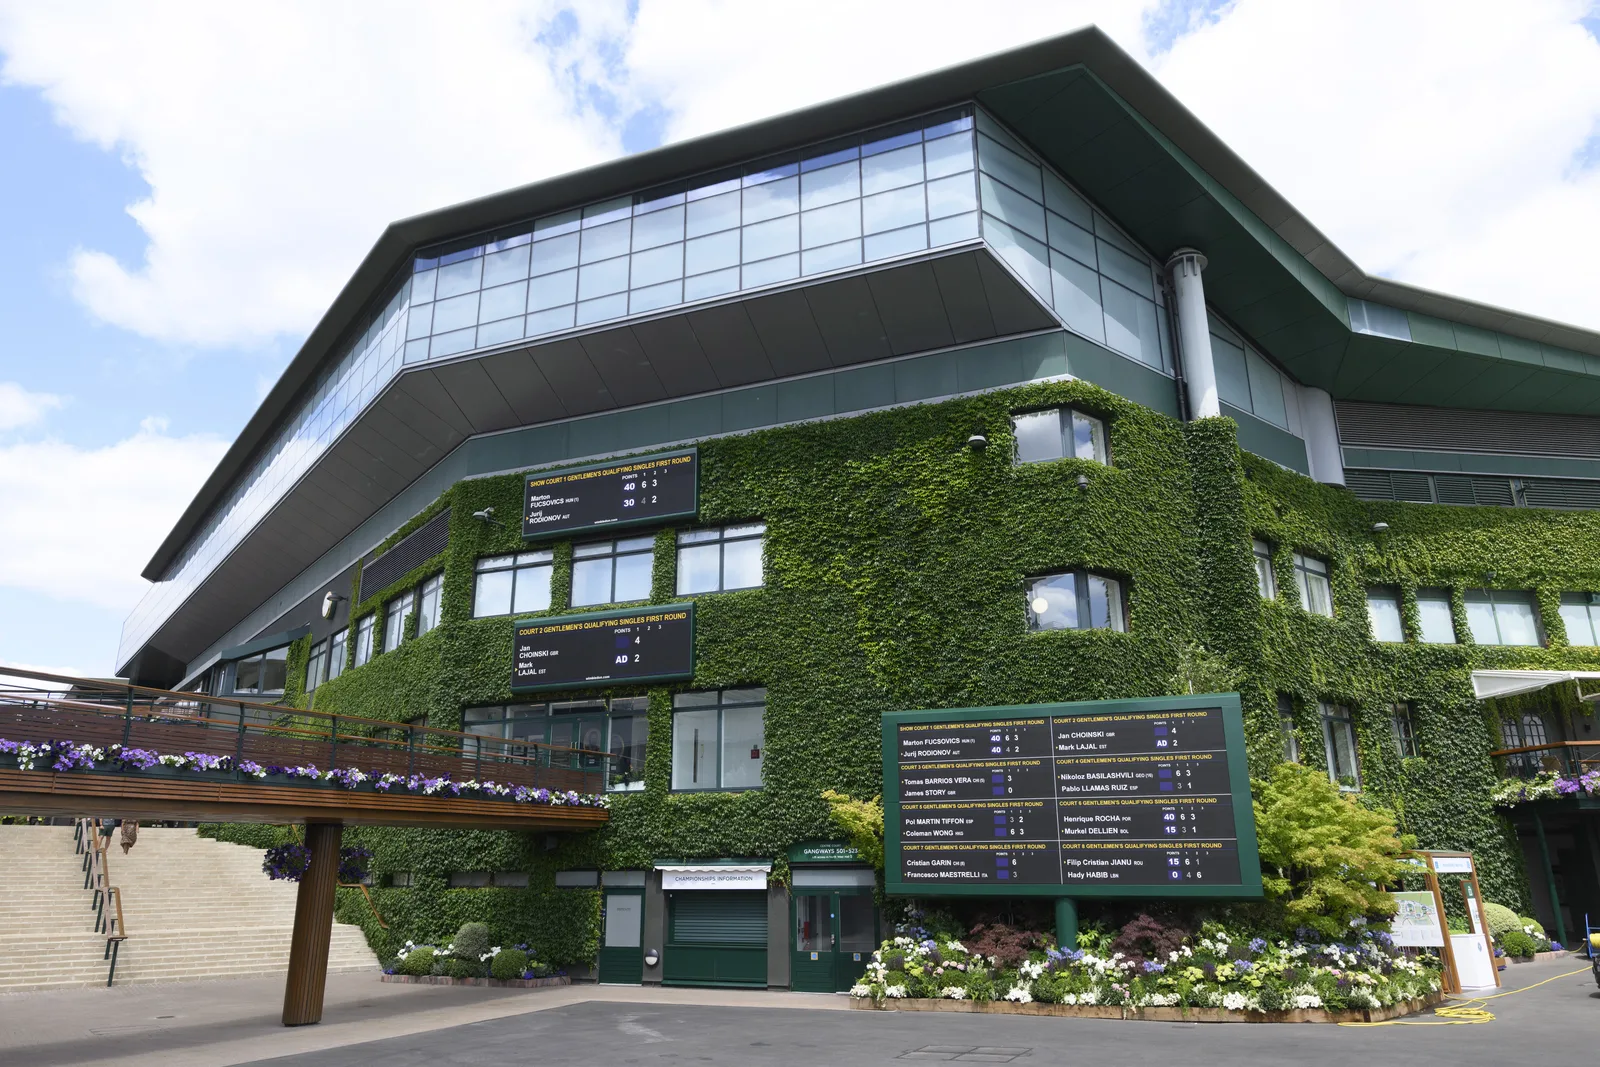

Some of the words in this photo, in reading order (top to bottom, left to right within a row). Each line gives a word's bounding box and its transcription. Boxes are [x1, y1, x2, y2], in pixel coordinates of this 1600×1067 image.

[568, 472, 601, 481] GENTLEMEN'S
[602, 467, 632, 476] QUALIFYING
[633, 463, 655, 471] SINGLES
[672, 456, 691, 464] ROUND
[530, 498, 564, 508] FUCSOVICS
[624, 499, 634, 507] 30
[529, 515, 561, 524] RODIONOV
[544, 624, 582, 633] GENTLEMEN'S
[584, 620, 618, 629] QUALIFYING
[620, 617, 644, 625] SINGLES
[616, 655, 628, 664] AD
